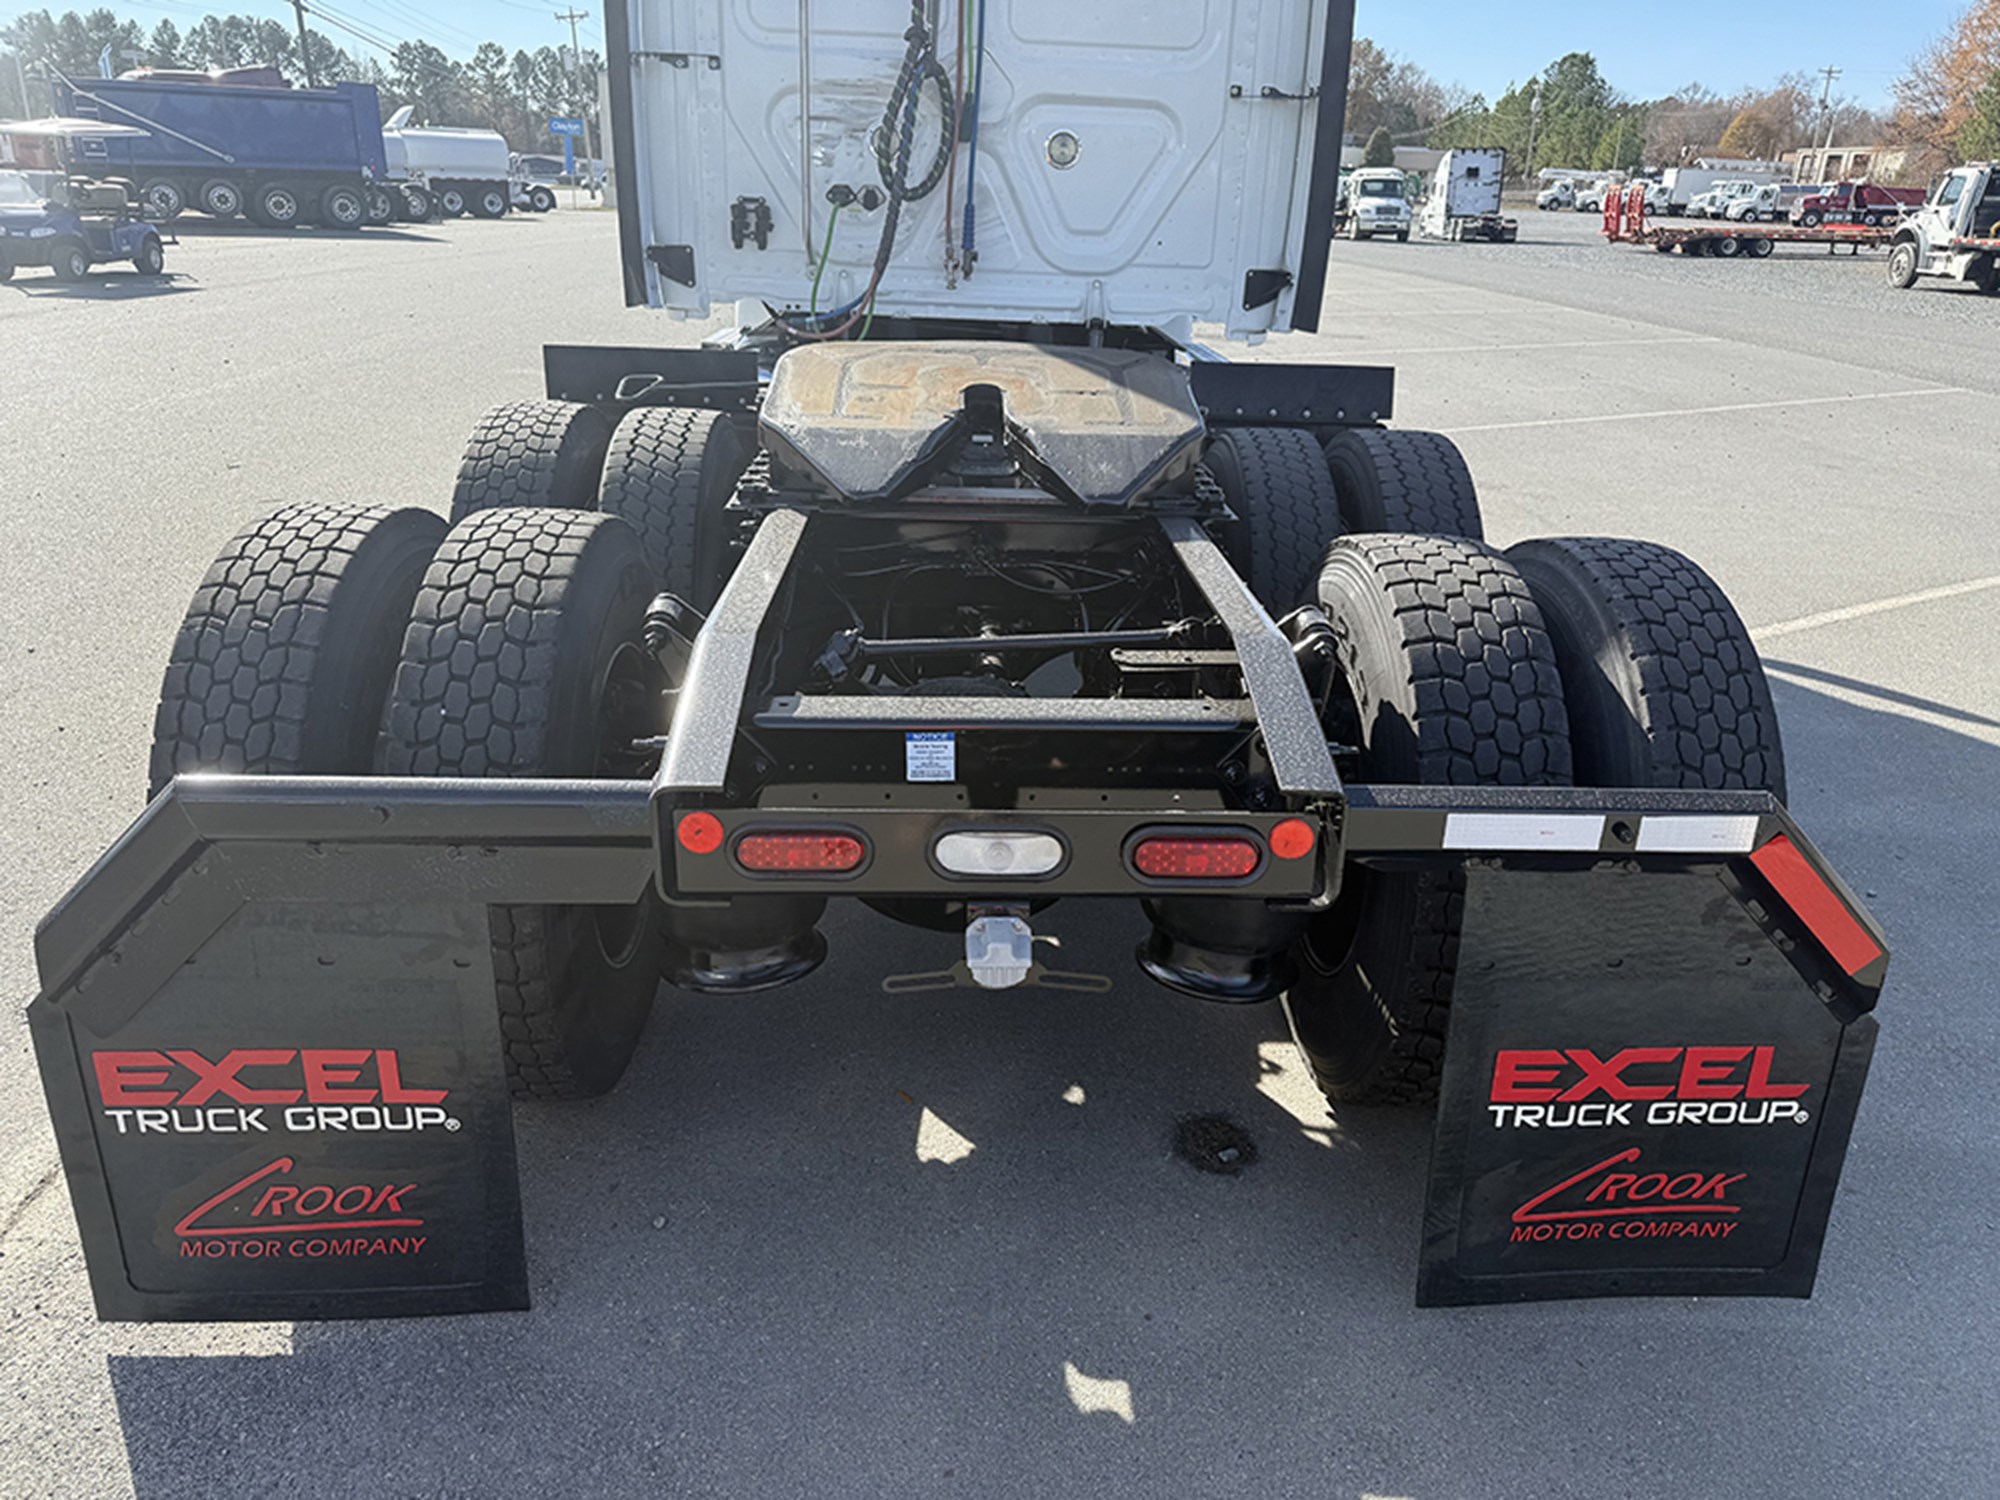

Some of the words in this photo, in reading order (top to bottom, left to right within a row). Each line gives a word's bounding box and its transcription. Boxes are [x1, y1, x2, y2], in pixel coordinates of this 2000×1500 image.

[92, 1049, 449, 1106] EXCEL
[1491, 1046, 1811, 1102] EXCEL
[104, 1108, 269, 1133] TRUCK
[1488, 1103, 1633, 1128] TRUCK
[1510, 1222, 1604, 1242] MOTOR
[1607, 1221, 1739, 1239] COMPANY
[180, 1240, 282, 1258] MOTOR
[288, 1237, 427, 1257] COMPANY
